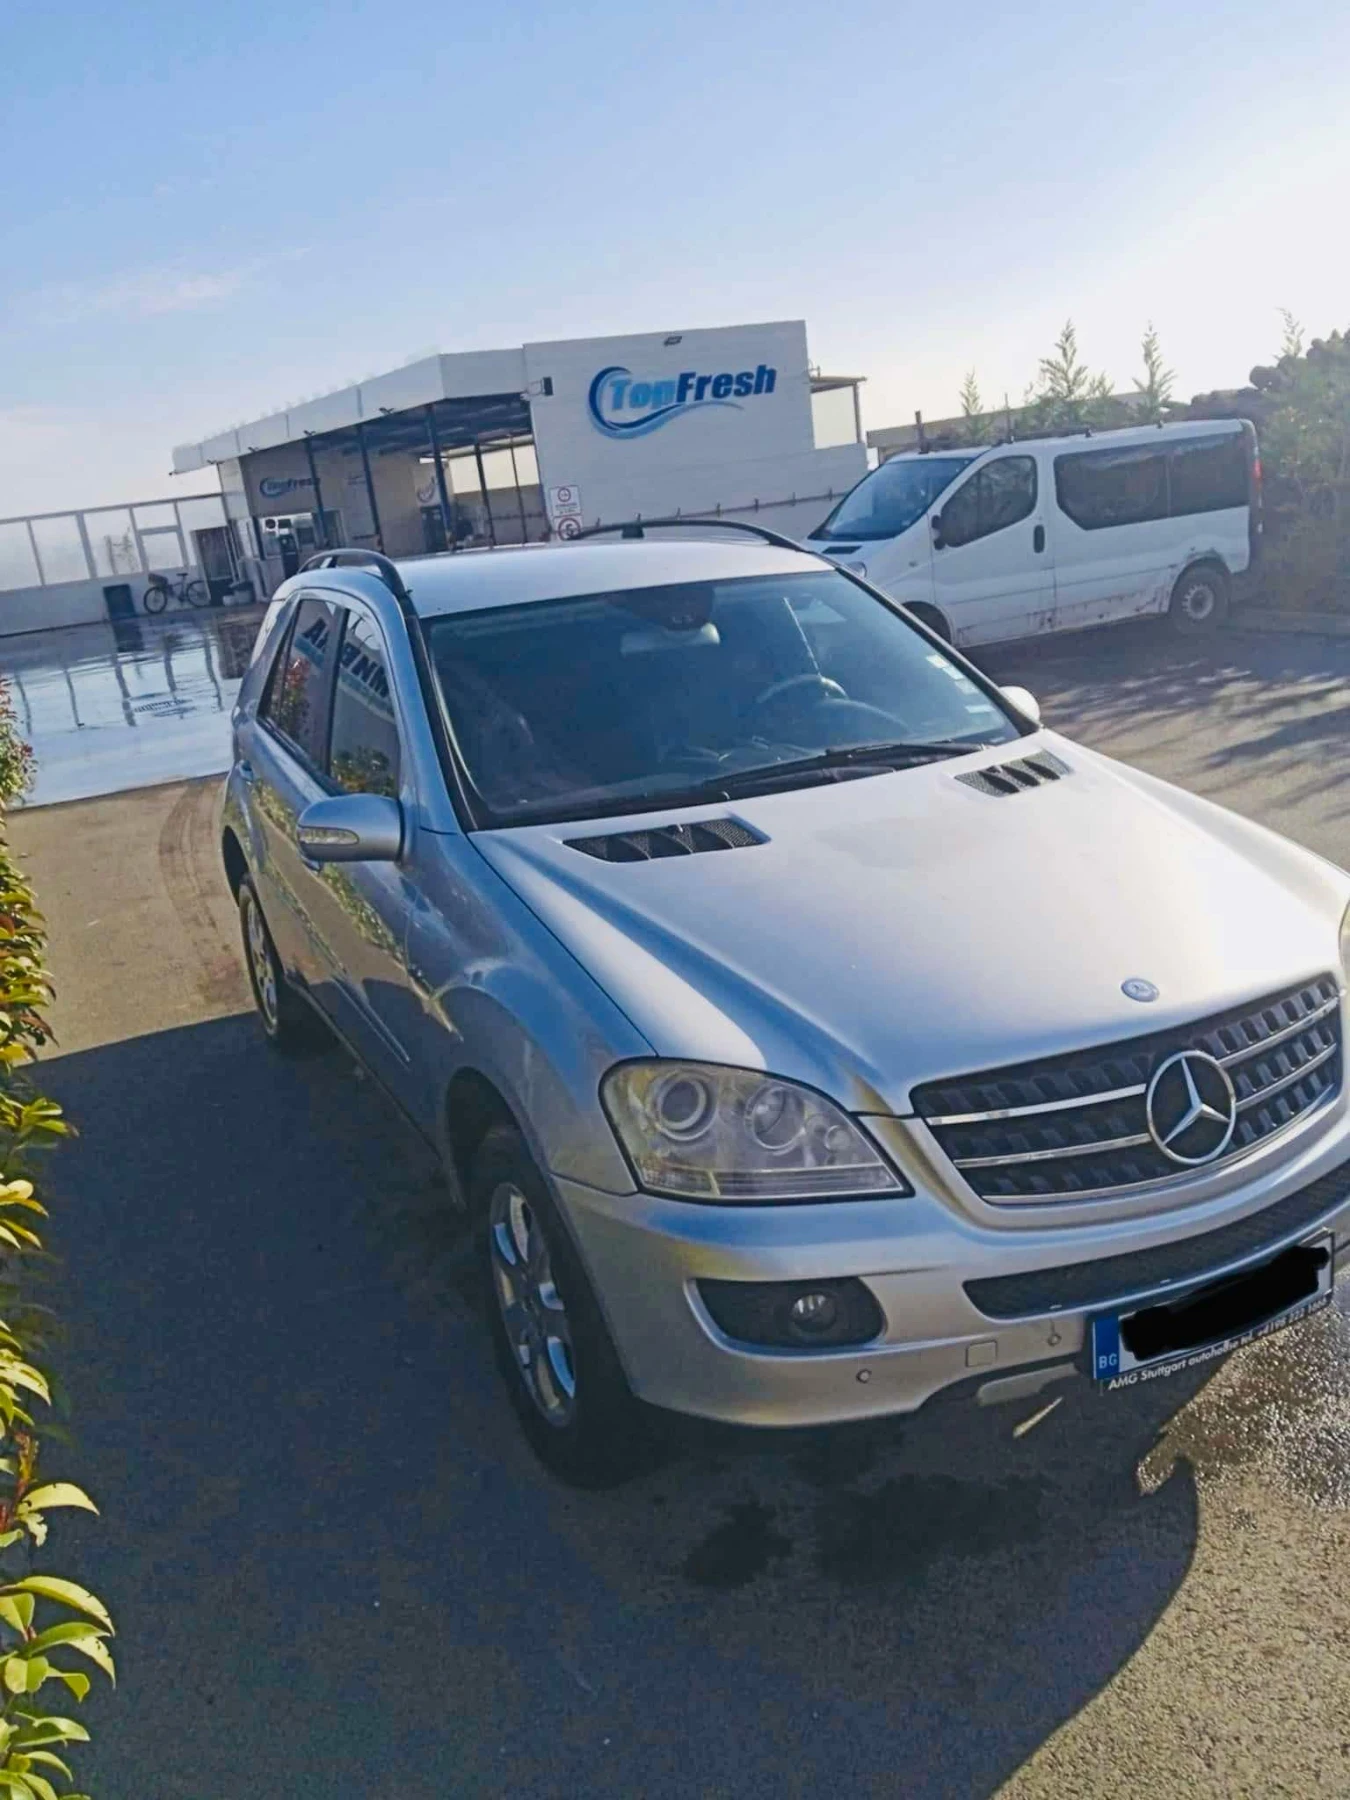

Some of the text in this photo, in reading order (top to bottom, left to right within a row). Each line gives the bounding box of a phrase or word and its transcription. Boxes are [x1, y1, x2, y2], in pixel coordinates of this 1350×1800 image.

[610, 364, 777, 411] TopFresh
[1099, 1352, 1118, 1370] BG
[1108, 1372, 1138, 1391] AMG
[1141, 1359, 1187, 1381] Stuttgart
